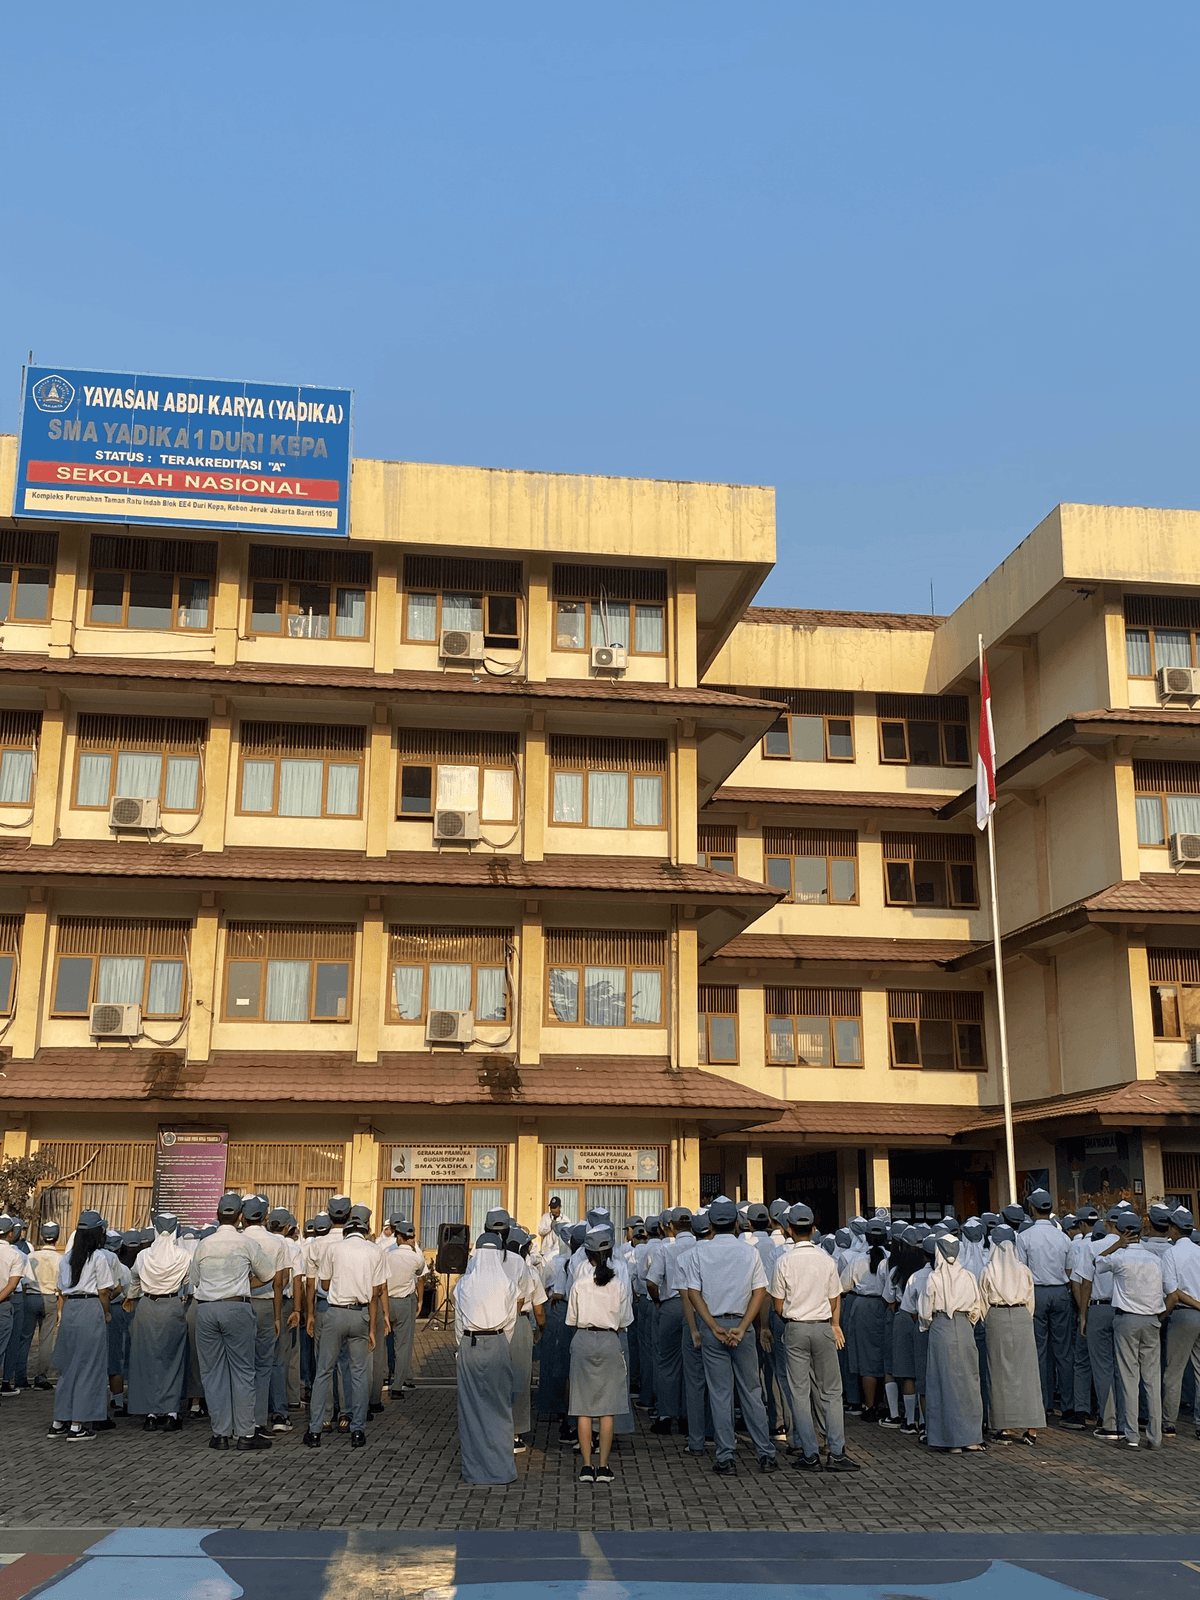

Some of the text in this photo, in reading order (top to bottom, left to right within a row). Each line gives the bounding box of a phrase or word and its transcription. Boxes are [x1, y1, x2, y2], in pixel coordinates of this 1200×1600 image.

[83, 385, 159, 411] YAYASAN
[163, 392, 203, 414] ABDI
[208, 394, 265, 419] KARYA
[268, 398, 344, 424] (YADIKA)
[48, 418, 328, 459] SMA YADIKA 1 DURI KEPA
[95, 450, 144, 463] STATUS
[160, 454, 262, 471] TERAKREDITASI
[268, 461, 286, 472] "A"
[56, 466, 308, 496] SEKOLAH NASIONAL
[31, 491, 64, 501] Kompleks
[65, 494, 103, 503] Perumahan
[104, 496, 125, 504] Taman
[127, 497, 142, 505] Ratu
[143, 498, 161, 506] Indah
[162, 499, 177, 507] Blok
[193, 501, 206, 509] Duri
[207, 502, 226, 512] Kepa,
[227, 503, 248, 511] Kebon
[249, 505, 267, 513] Jeruk
[269, 507, 295, 515] Jakarta
[296, 508, 314, 516] Barat
